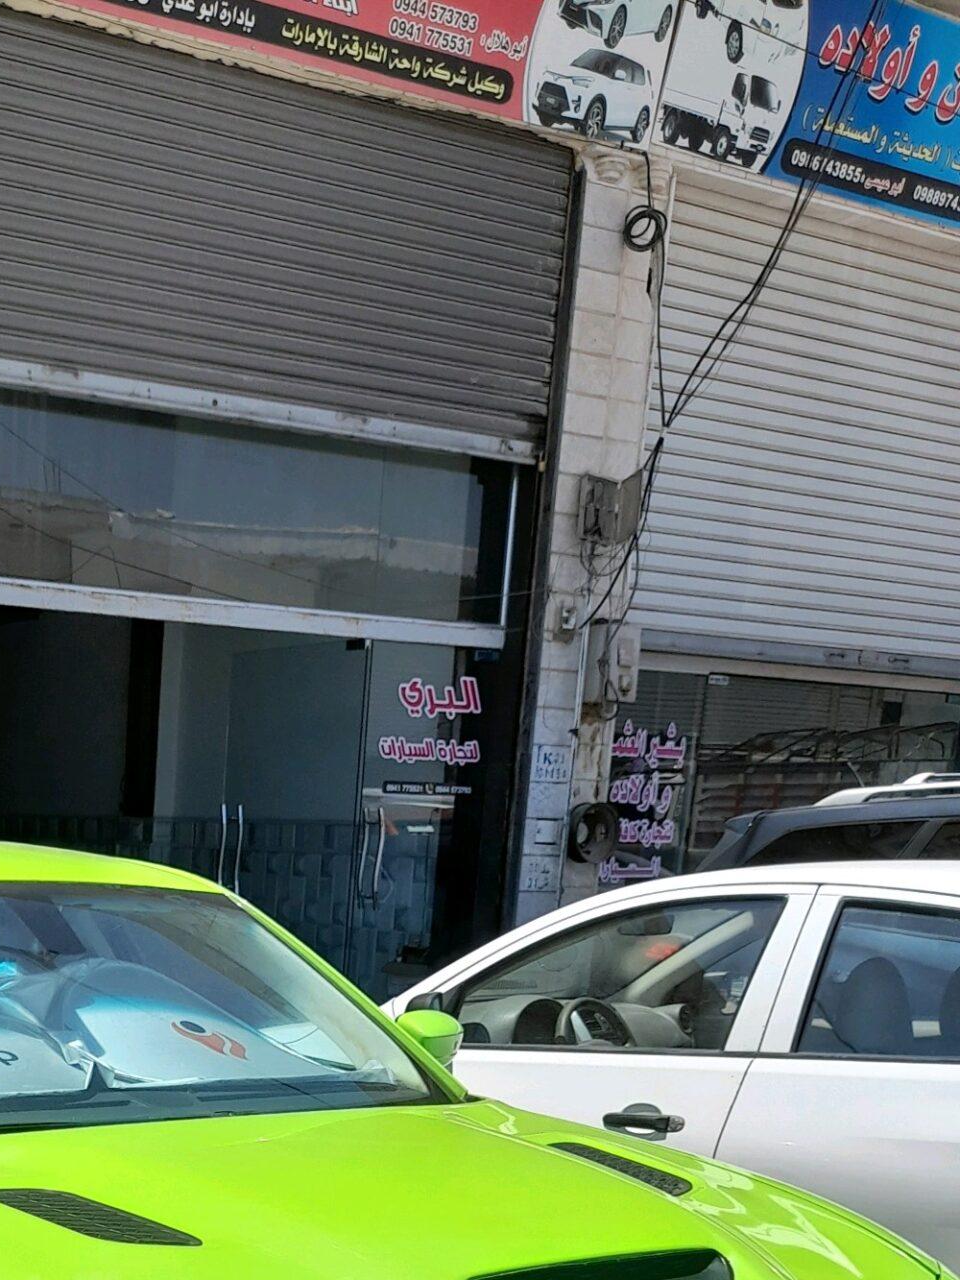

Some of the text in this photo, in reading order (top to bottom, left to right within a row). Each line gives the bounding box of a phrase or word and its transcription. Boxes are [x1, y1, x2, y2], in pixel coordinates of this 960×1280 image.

[429, 4, 479, 33] 573793
[339, 34, 388, 63] الشارقة
[389, 17, 473, 56] 0941 775531
[389, 48, 421, 78] واحة
[423, 57, 467, 86] شركة
[466, 71, 505, 99] وكيل
[399, 676, 481, 720] البري
[379, 736, 480, 766] لتجارة السيارات
